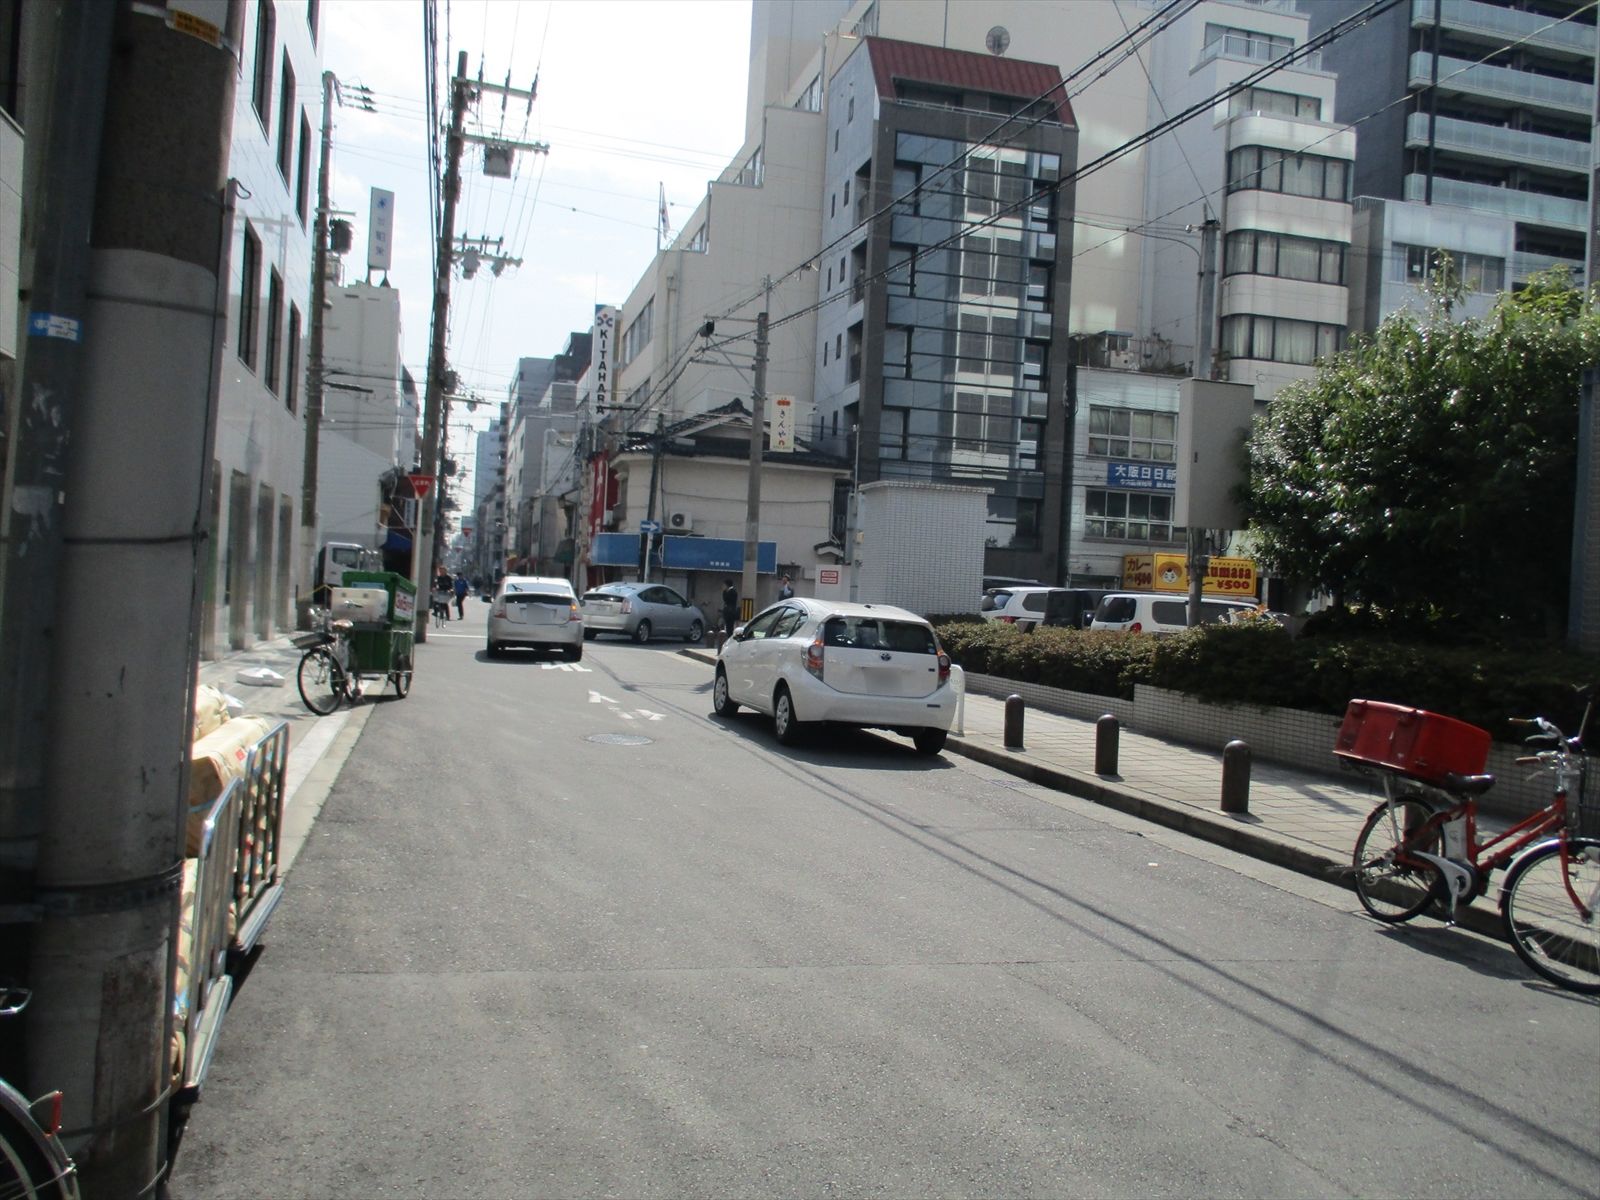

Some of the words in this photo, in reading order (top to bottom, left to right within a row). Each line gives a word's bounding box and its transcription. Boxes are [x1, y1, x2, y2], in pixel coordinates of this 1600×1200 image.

[595, 329, 608, 415] KITAHARA
[1115, 465, 1176, 480] 大阪日日新
[1128, 558, 1151, 571] カレー
[1217, 579, 1250, 590] ¥500
